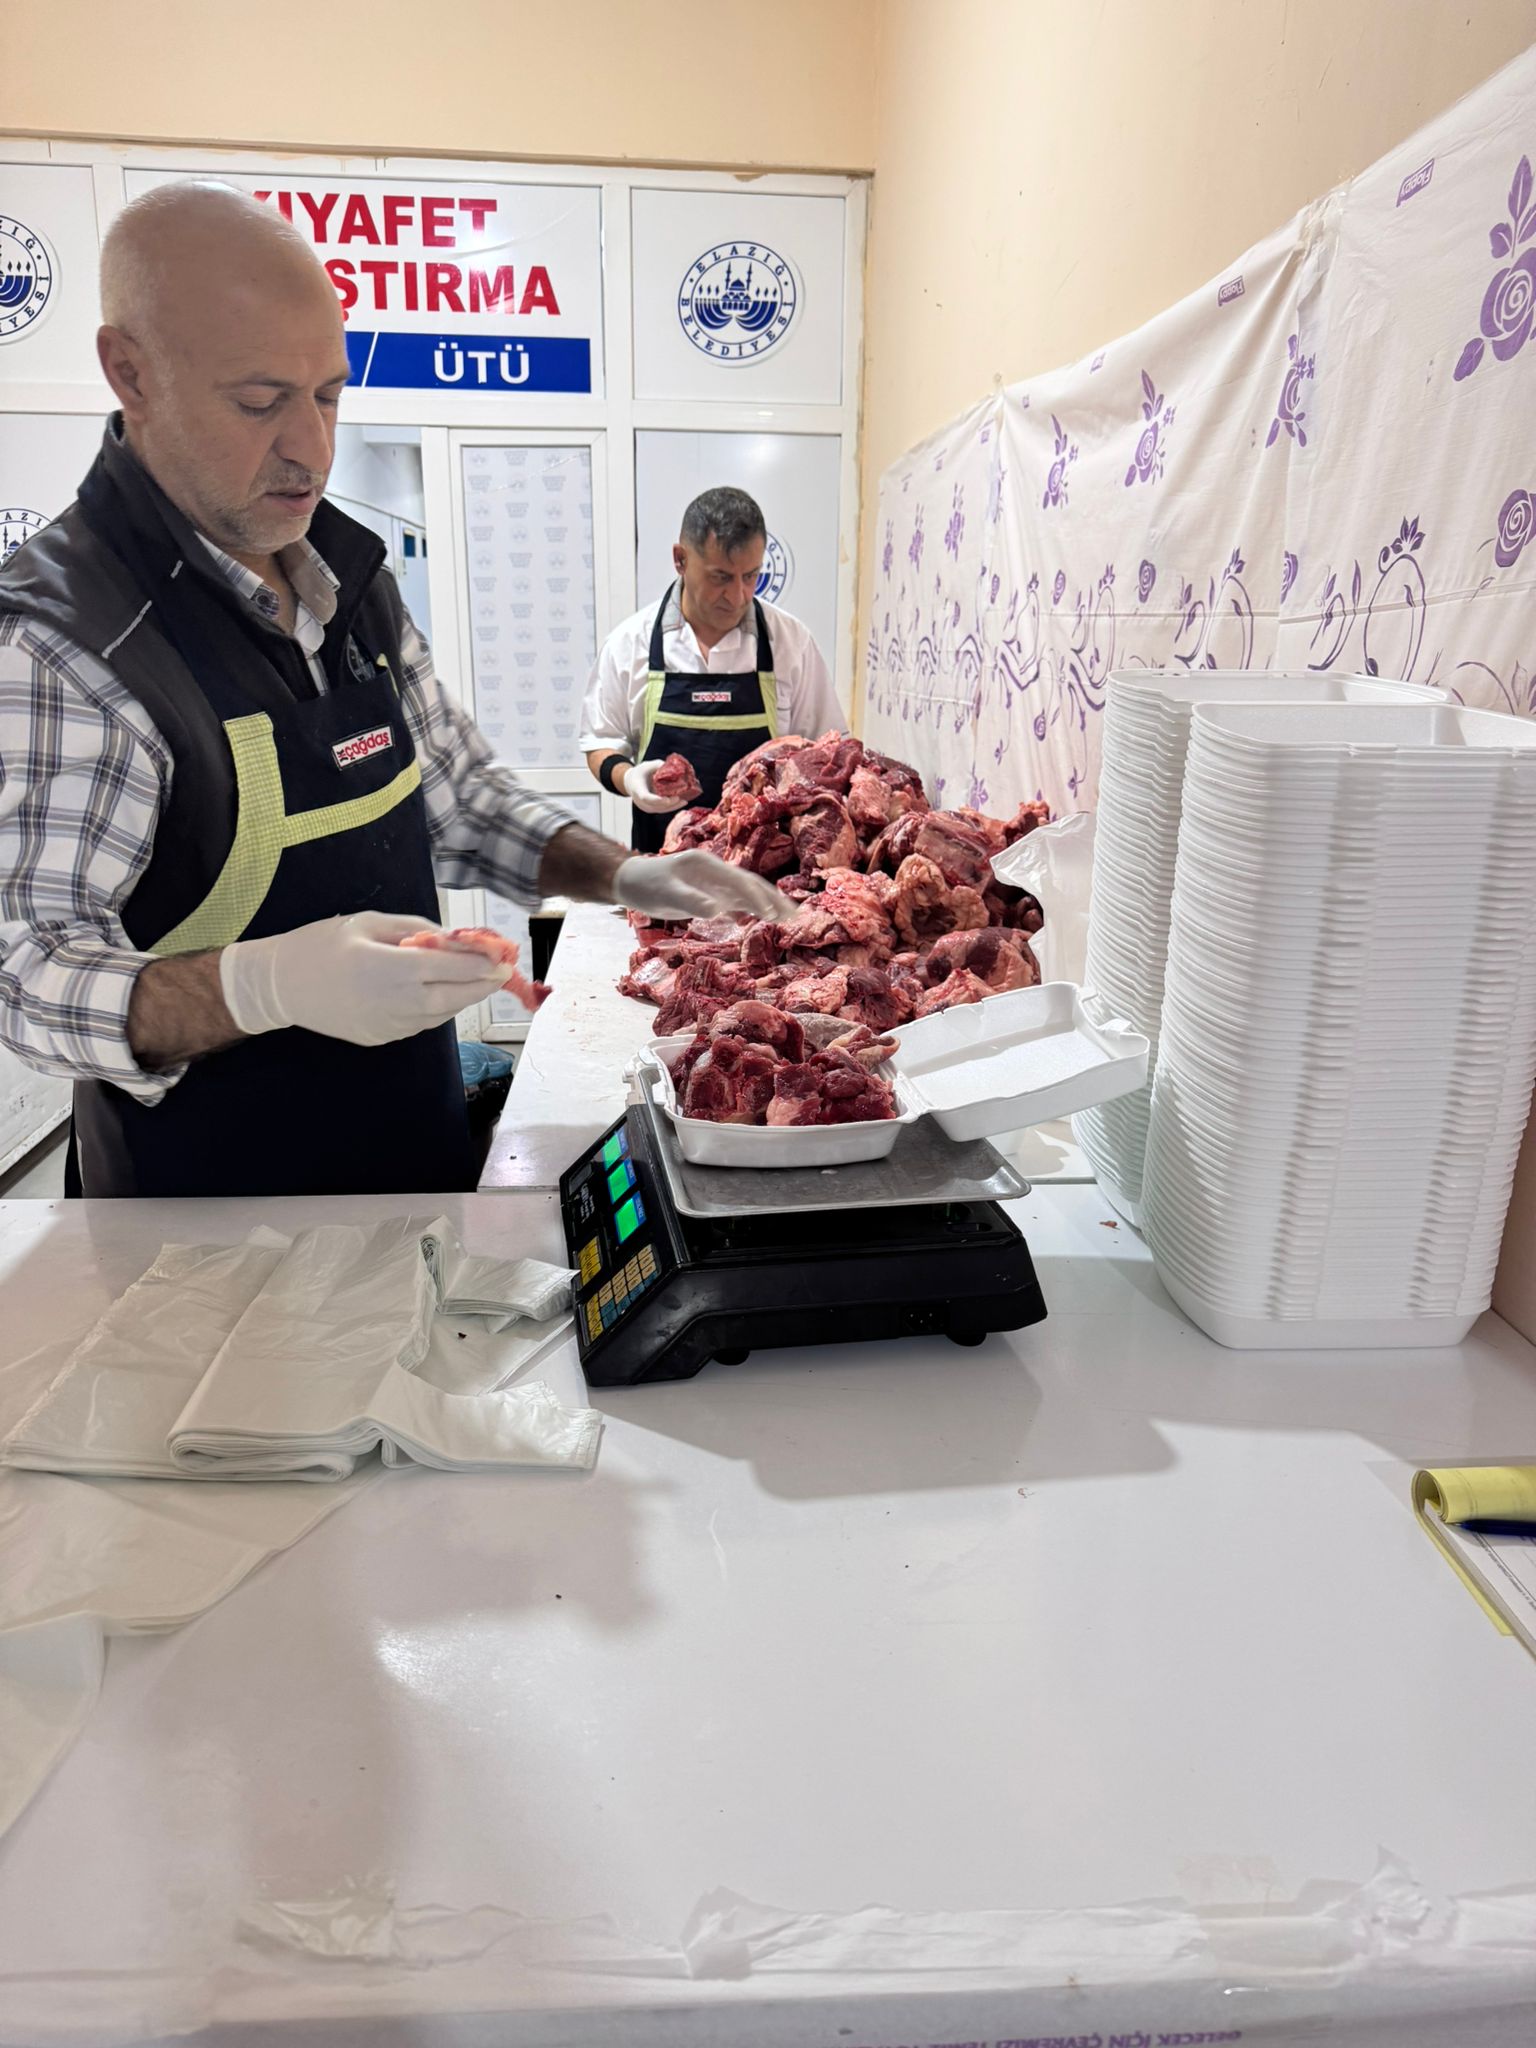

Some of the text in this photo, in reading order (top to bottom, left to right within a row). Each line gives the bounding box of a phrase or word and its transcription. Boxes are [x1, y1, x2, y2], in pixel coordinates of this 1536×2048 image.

[695, 244, 786, 276] ELAZIĞ
[680, 298, 793, 356] BELEDİYESİ
[433, 342, 531, 385] ÜTÜ
